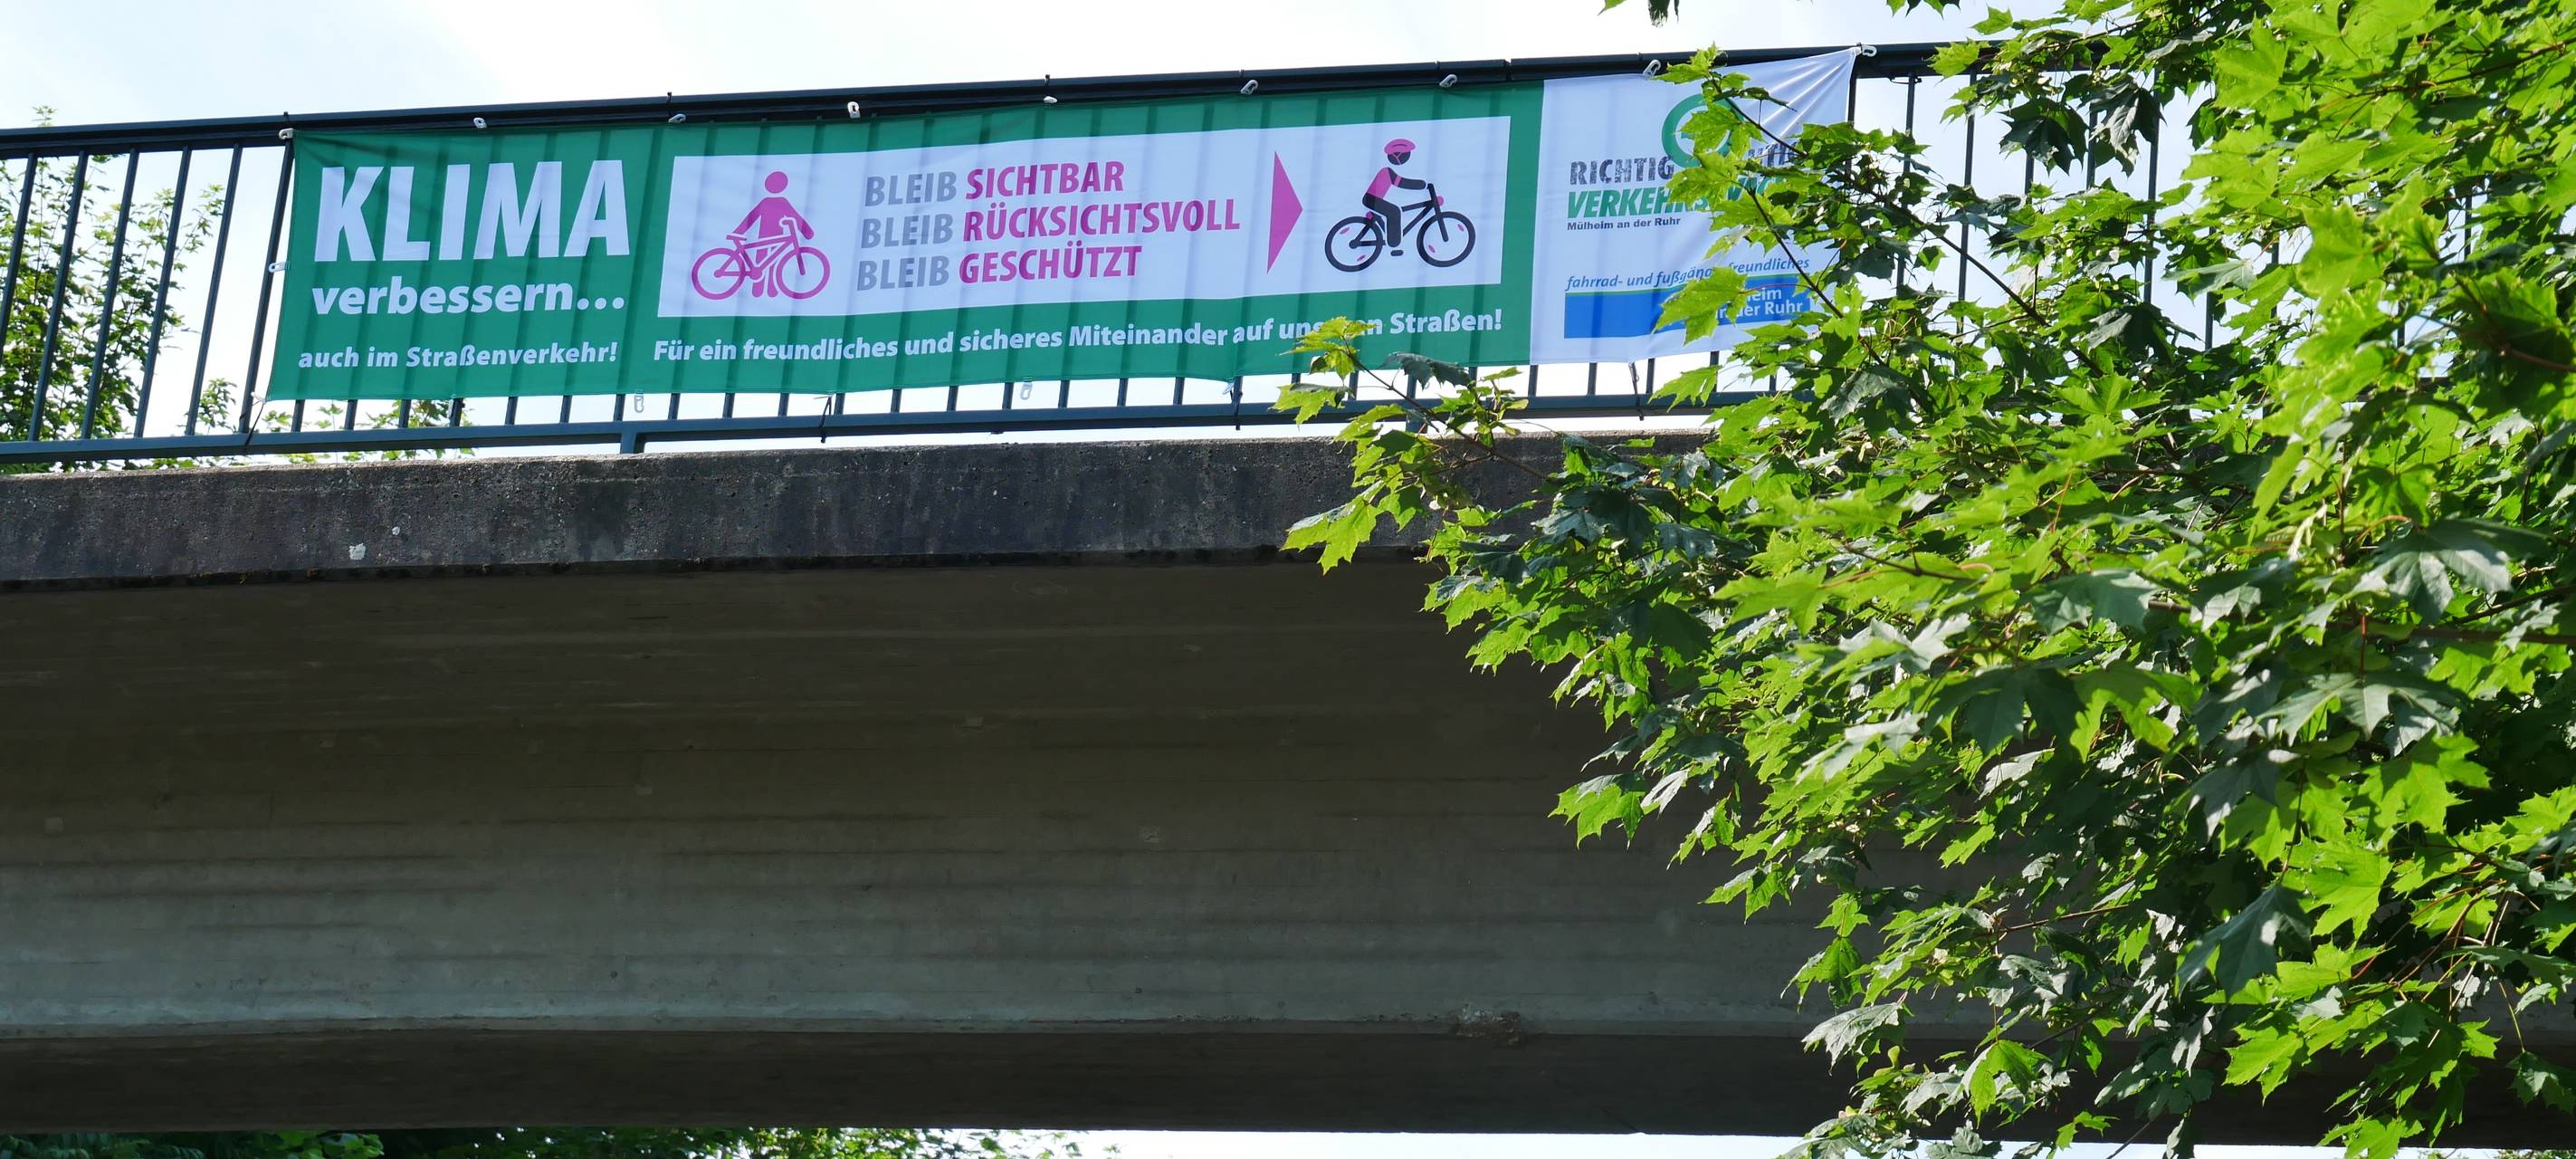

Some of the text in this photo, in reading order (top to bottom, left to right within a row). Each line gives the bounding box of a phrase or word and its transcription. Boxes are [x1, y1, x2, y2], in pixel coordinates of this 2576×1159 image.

[864, 161, 1125, 207] BLEIB SICHTBAR
[1569, 156, 1674, 186] RICHTIG
[314, 159, 630, 262] KLIMA
[861, 198, 1241, 249] BLEIB RÜCKSICHTSVOLL
[1567, 220, 1614, 231] Mülheim
[1633, 219, 1652, 228] der
[1655, 216, 1682, 226] Ruhr
[856, 240, 1143, 292] BLEIB GESCHÜTZT
[1565, 275, 1623, 292] fahrrad-
[1627, 273, 1655, 287] und
[311, 275, 625, 315] verbessern...
[1764, 300, 1803, 315] Ruhr
[298, 340, 618, 368] auch im Straßenverkehr!
[654, 340, 694, 360] Für
[699, 339, 737, 360] ein
[742, 337, 899, 360] freundliches
[904, 331, 954, 356] und
[959, 329, 1063, 353] sicheres
[1069, 322, 1227, 347] Miteinander
[1232, 317, 1274, 344] auf
[1389, 309, 1503, 335] Straßen!
